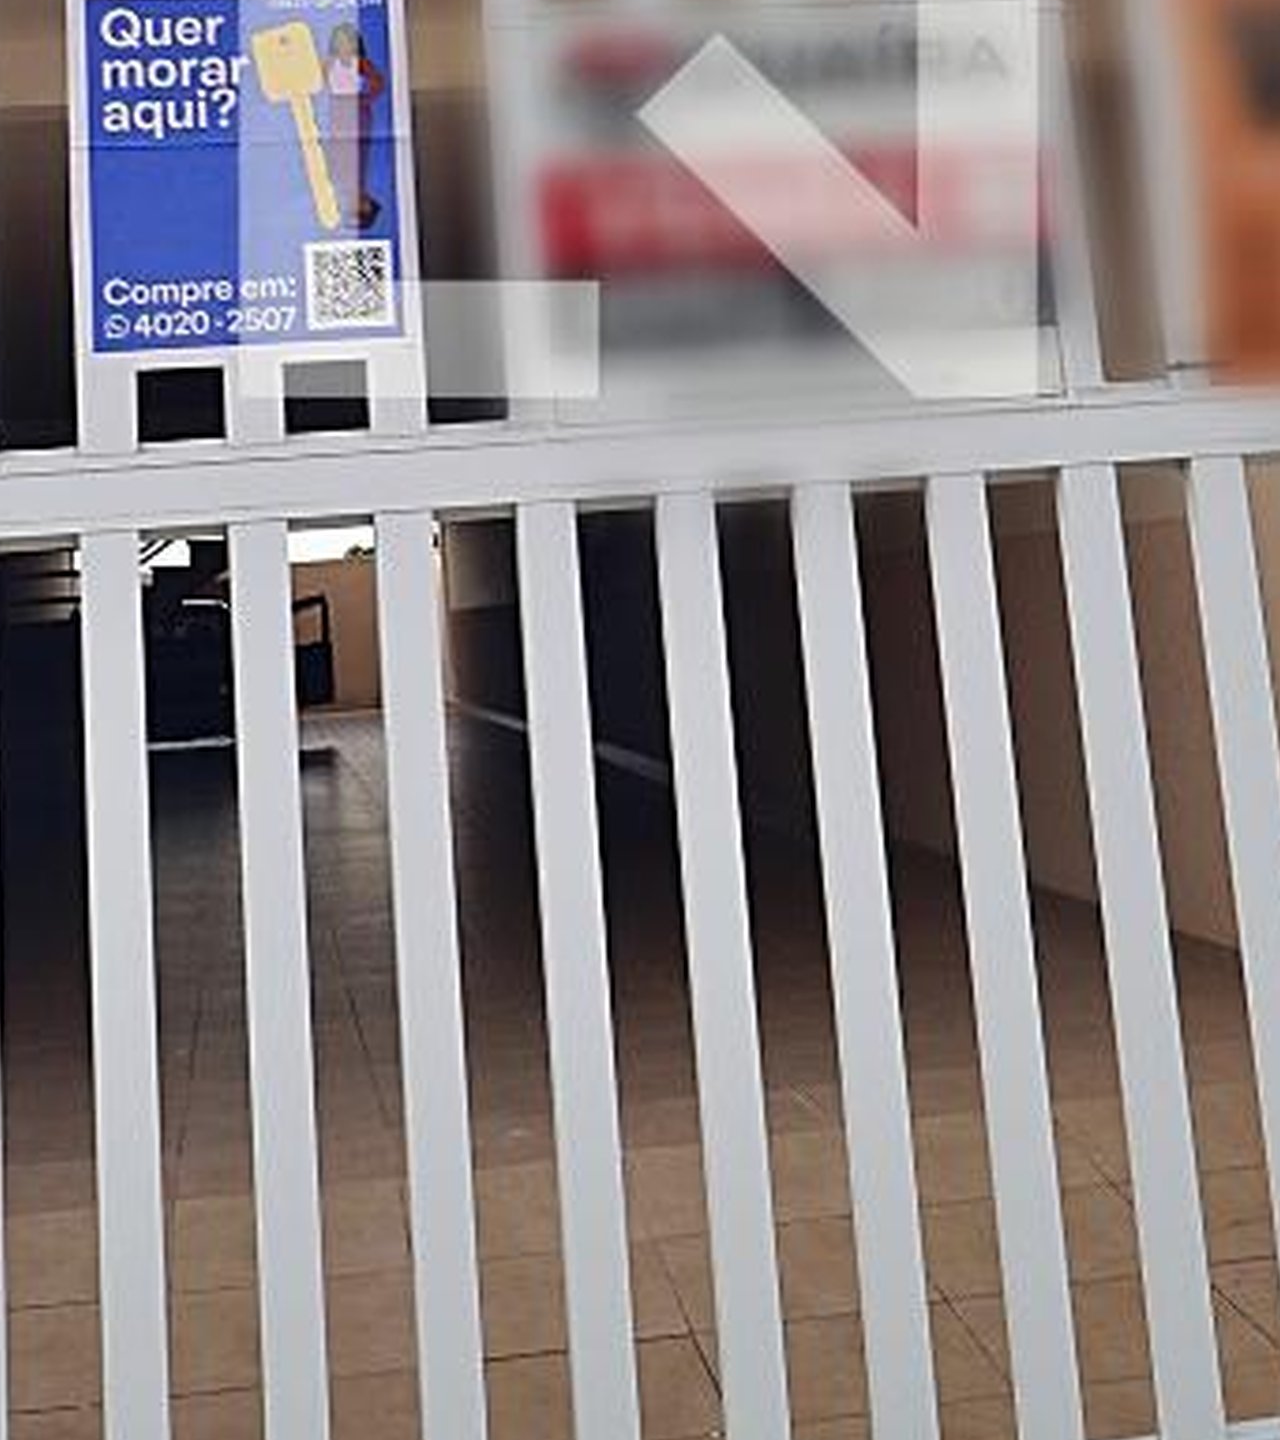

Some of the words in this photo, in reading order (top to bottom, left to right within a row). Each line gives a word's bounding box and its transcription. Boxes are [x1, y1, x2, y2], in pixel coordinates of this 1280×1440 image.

[100, 7, 224, 48] Quer
[101, 53, 248, 89] morar
[102, 91, 236, 139] aqui?
[103, 276, 233, 310] Compre
